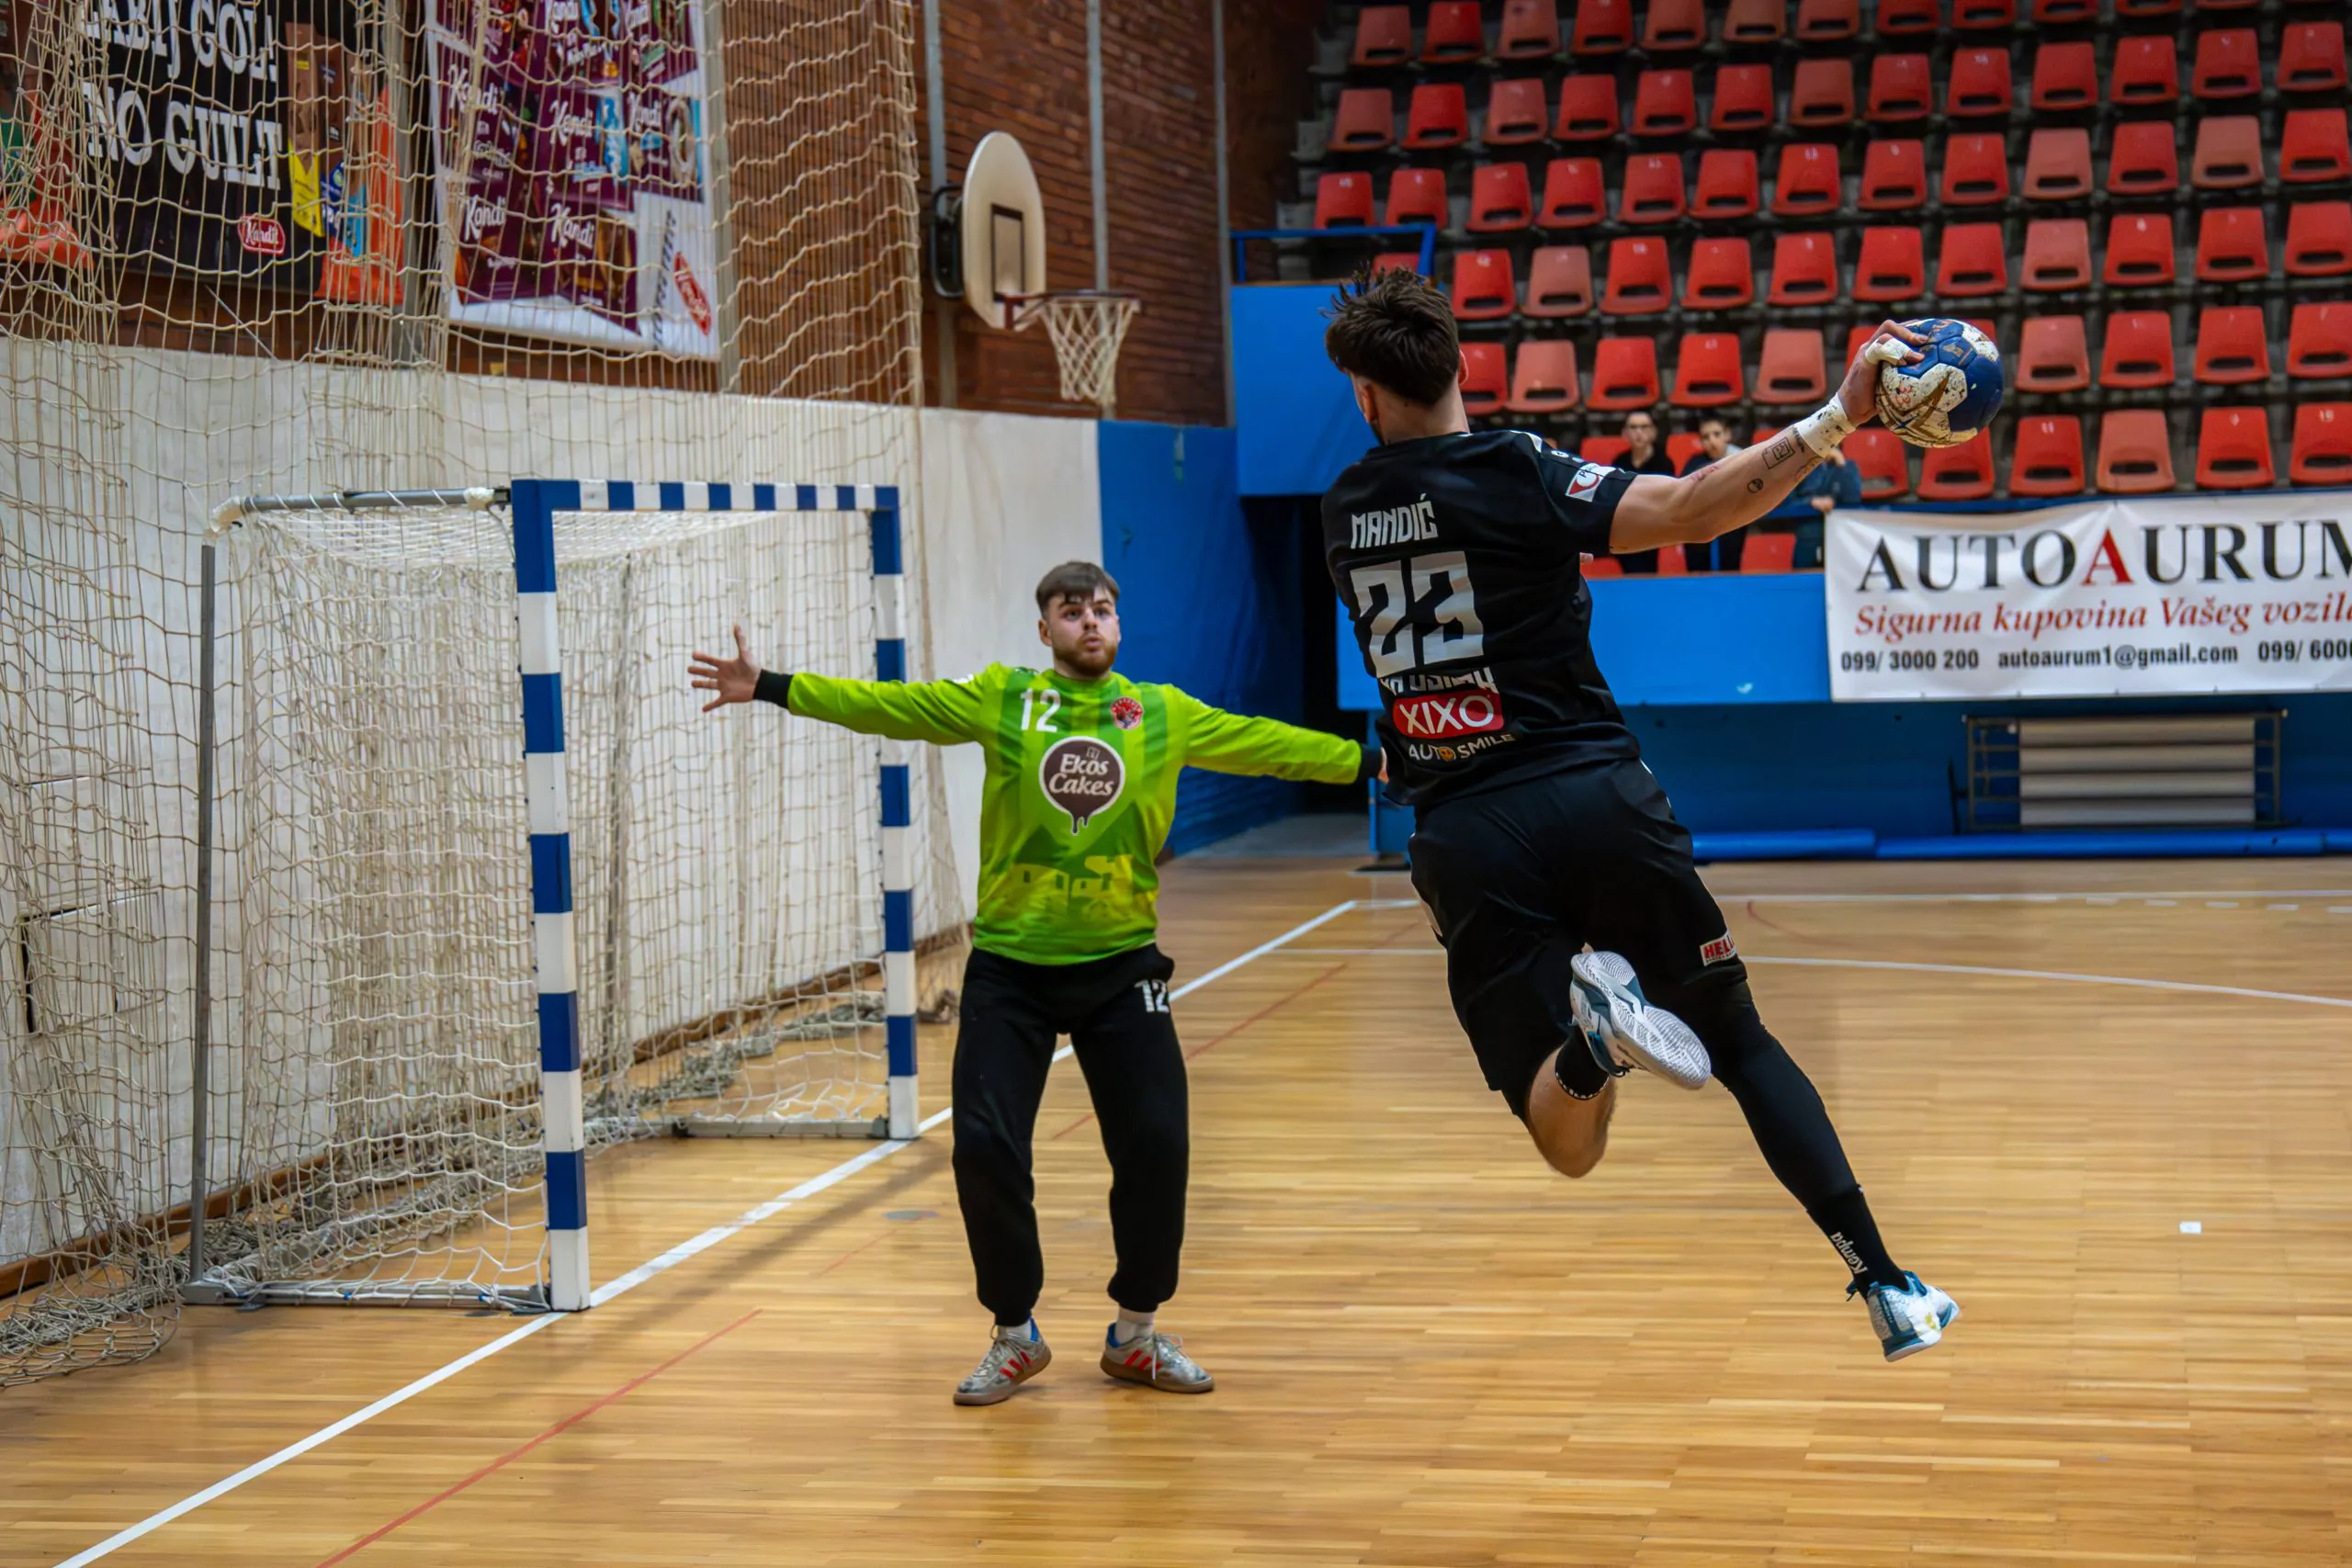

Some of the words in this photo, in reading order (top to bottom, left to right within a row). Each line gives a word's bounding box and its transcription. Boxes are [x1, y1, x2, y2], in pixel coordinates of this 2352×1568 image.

[83, 82, 152, 166] NO
[551, 202, 595, 249] Kandi
[1351, 493, 1438, 549] MANDIĆ
[1350, 551, 1484, 678] 23
[1854, 604, 1983, 644] Sigurna
[1992, 599, 2148, 641] kupovina
[2160, 595, 2253, 636] Vašeg
[1841, 649, 1882, 672] 099/
[1889, 650, 1937, 671] 3000
[1943, 649, 1980, 671] 200
[1997, 643, 2239, 671] autoaurum1@gmail.com
[2256, 640, 2302, 664] 099/
[2310, 638, 2352, 660] 600
[1020, 687, 1061, 733] 12
[1398, 694, 1495, 736] XIXO
[1059, 753, 1110, 775] Ekos
[1457, 733, 1516, 760] SMILE
[1048, 772, 1114, 796] Cakes
[1134, 978, 1170, 1014] 12
[1830, 1231, 1869, 1275] Kempa
